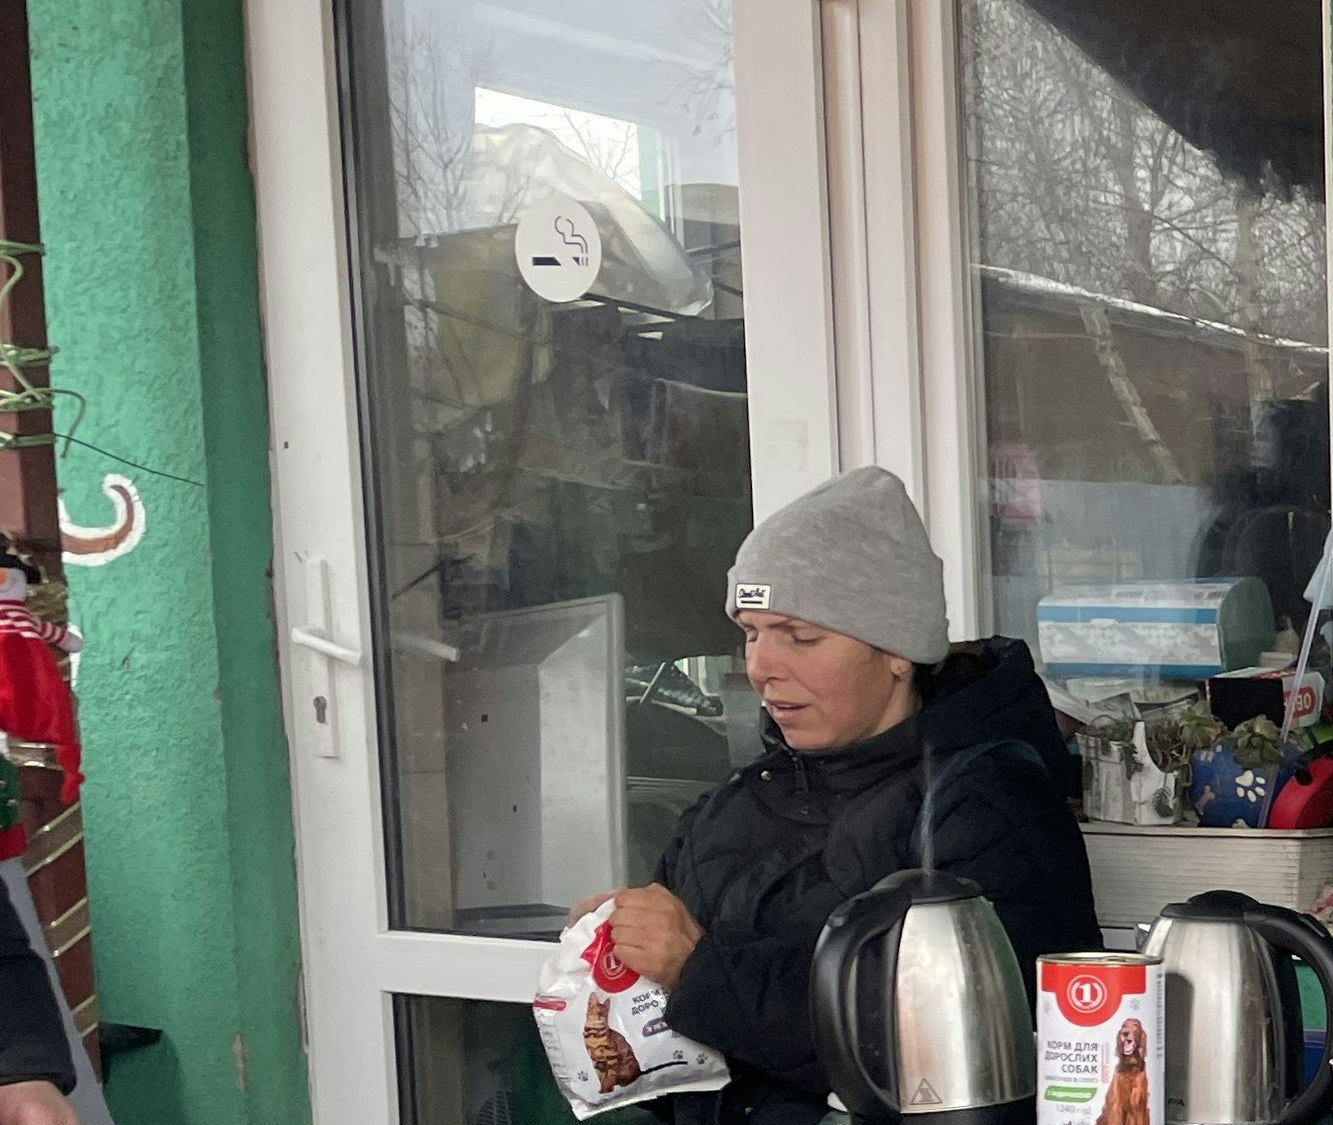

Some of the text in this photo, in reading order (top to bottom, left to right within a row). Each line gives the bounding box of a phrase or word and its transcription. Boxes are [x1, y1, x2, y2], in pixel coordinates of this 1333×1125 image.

[1047, 1041, 1098, 1052] КОРМ ДЛЯ
[1044, 1051, 1098, 1063] ДОРОСЛИХ
[1061, 1064, 1098, 1074] СОБАК
